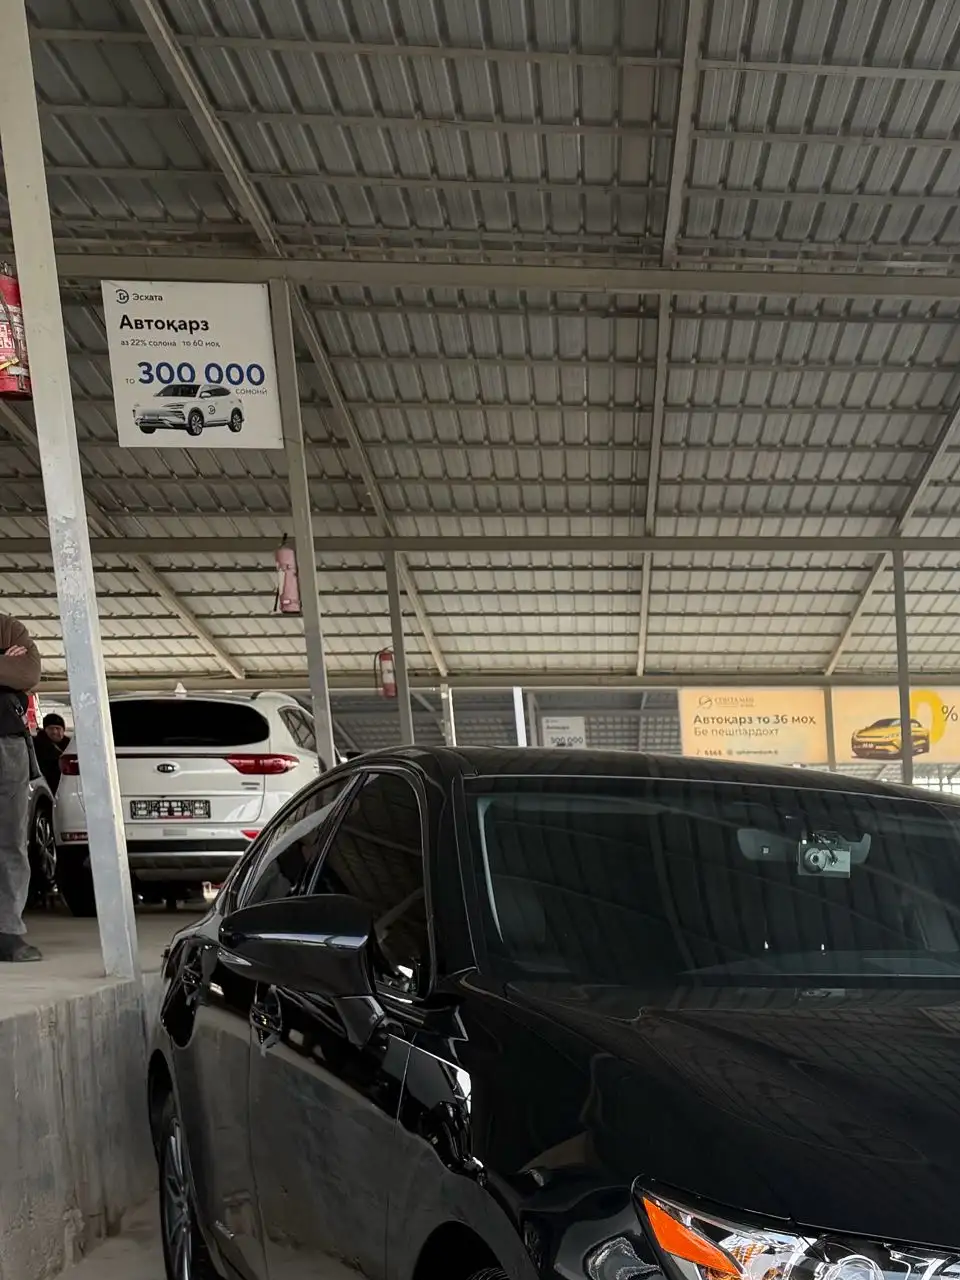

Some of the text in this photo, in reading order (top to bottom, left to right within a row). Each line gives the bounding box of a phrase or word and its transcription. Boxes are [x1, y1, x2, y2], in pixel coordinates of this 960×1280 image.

[132, 293, 163, 301] Эсхата
[119, 314, 209, 335] Автоқарз
[193, 339, 203, 347] 60
[137, 361, 196, 384] 300
[204, 362, 265, 386] 000
[693, 714, 753, 726] Автоқарз
[757, 716, 770, 724] то
[773, 714, 788, 724] 36
[694, 727, 779, 738] Бе пешпардохт
